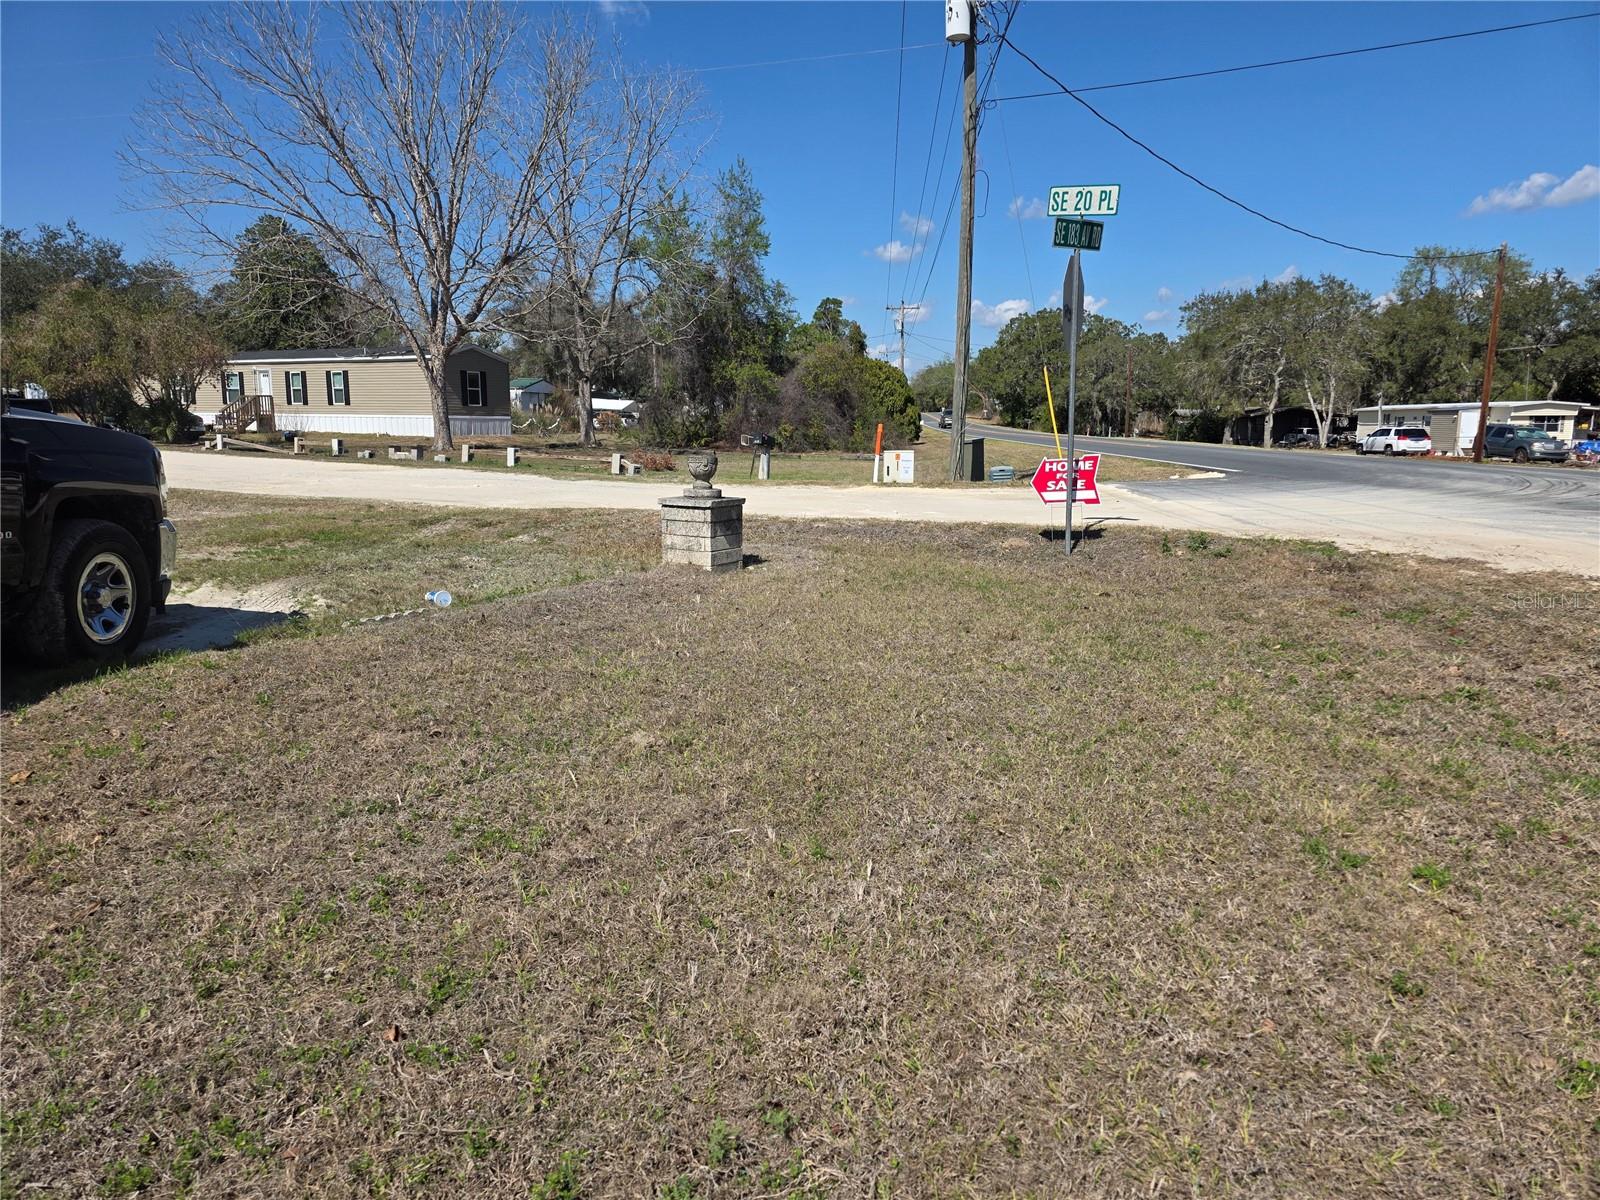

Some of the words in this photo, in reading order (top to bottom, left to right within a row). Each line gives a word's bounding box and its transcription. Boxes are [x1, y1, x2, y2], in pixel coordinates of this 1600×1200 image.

[1051, 191, 1069, 212] SE
[1074, 190, 1093, 211] 20
[1098, 190, 1114, 211] PL
[1056, 222, 1067, 244] SE
[1068, 224, 1080, 245] 183
[1045, 461, 1094, 472] HOME
